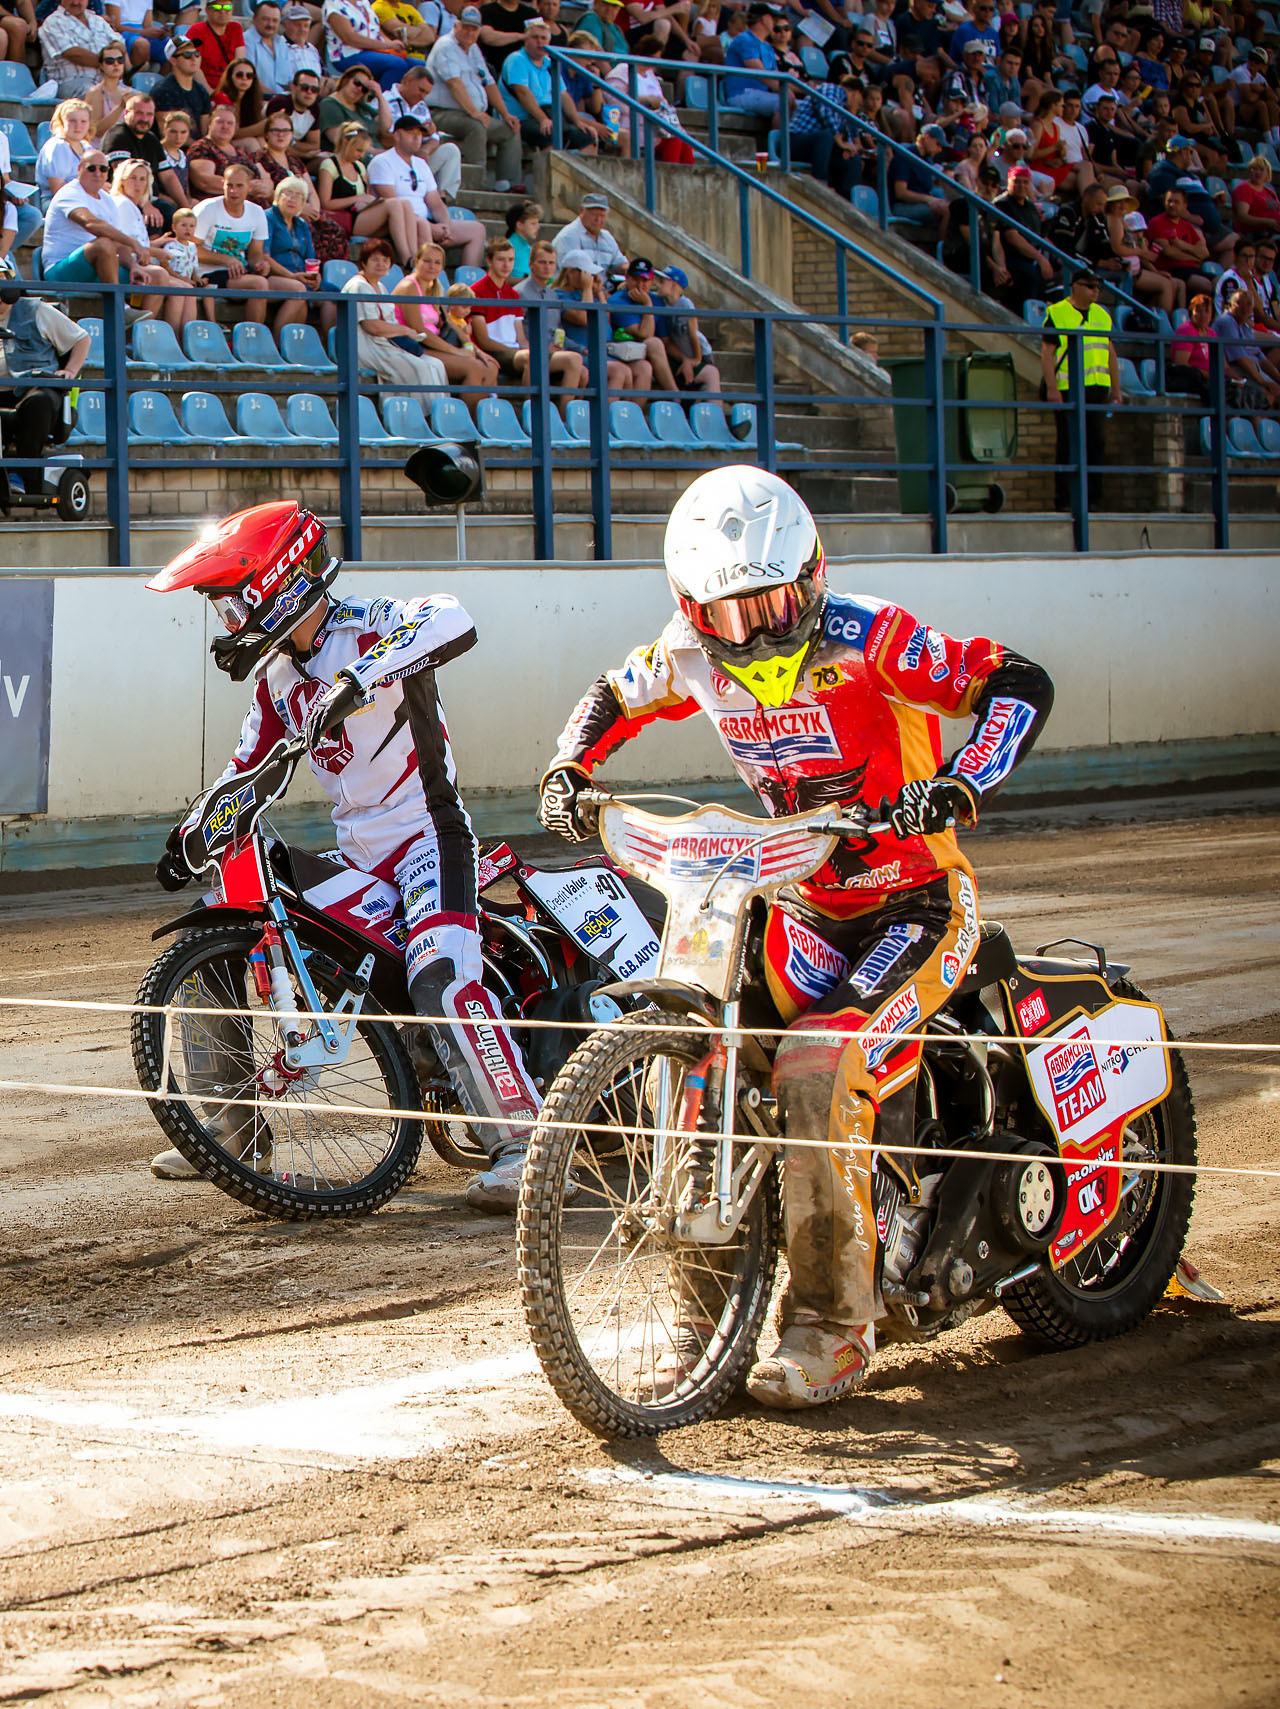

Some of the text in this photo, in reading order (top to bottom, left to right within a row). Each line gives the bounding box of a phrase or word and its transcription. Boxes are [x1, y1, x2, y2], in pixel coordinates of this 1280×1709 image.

[719, 711, 827, 742] ABRAMCZYK
[671, 836, 756, 860] ABRAMCZYK
[545, 875, 588, 912] Credit Value
[595, 872, 626, 901] #91
[583, 913, 615, 938] REALL
[1050, 1037, 1091, 1077] ABRAMCZYK
[1101, 1053, 1122, 1072] NITRO
[1057, 1074, 1105, 1126] TEAM
